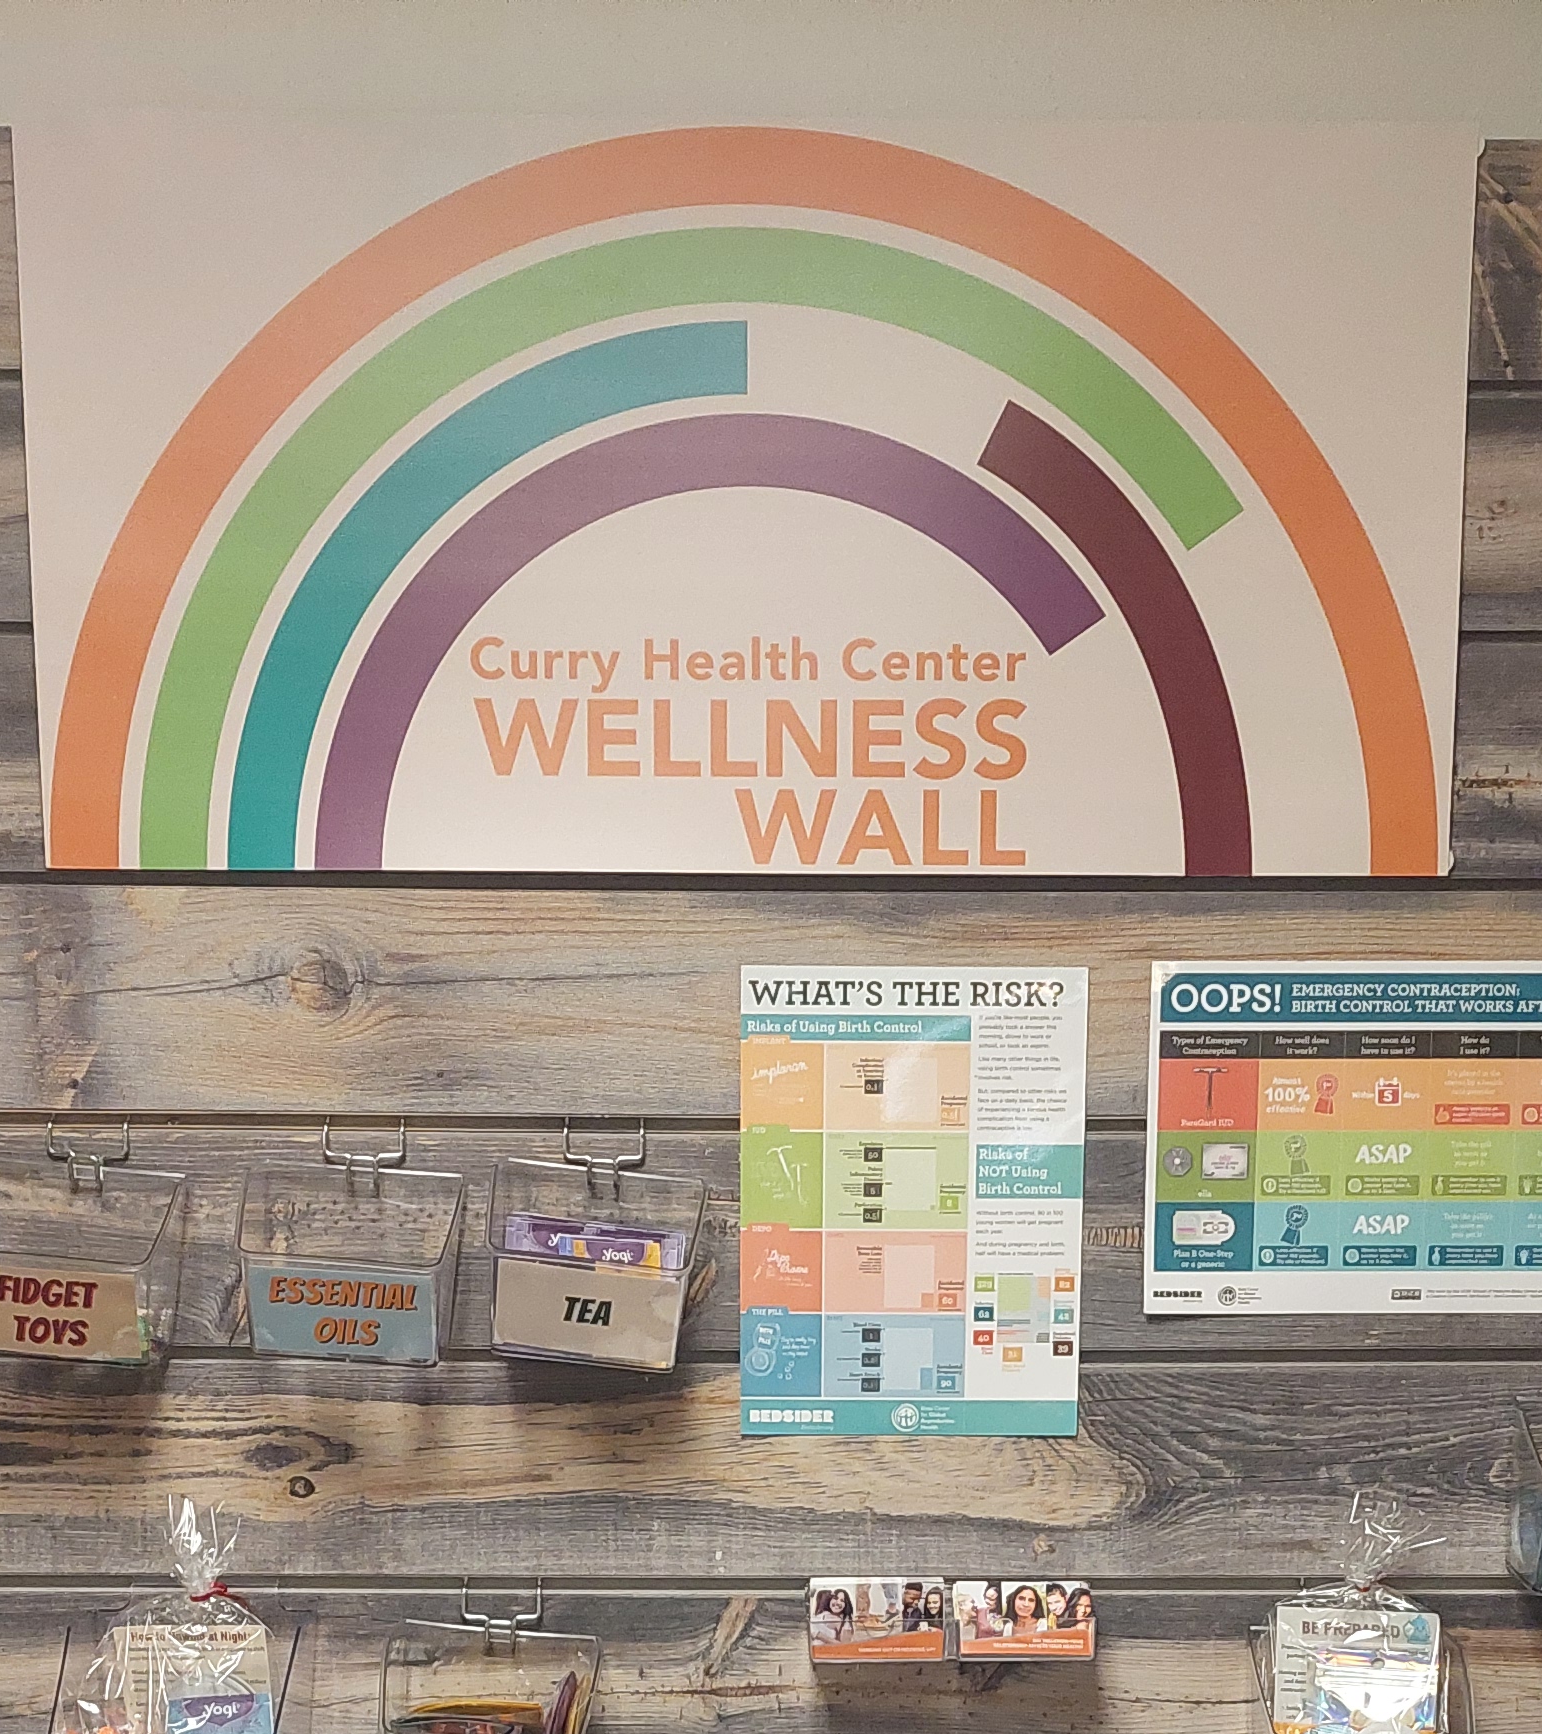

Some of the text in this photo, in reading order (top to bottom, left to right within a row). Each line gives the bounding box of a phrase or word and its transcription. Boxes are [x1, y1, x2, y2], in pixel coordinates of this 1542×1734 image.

[469, 636, 1027, 693] Curry Health Center
[473, 696, 1028, 781] WELLNESS
[734, 788, 1027, 867] WALL
[748, 979, 883, 1007] WHAT'S
[893, 981, 960, 1007] THE
[1171, 983, 1282, 1013] OOPS!
[1291, 984, 1384, 997] EMERGENCY
[1291, 1000, 1337, 1013] BIRTH
[1339, 1000, 1412, 1013] CONTROL
[1415, 1000, 1457, 1013] THAT
[1459, 1000, 1514, 1013] WORKS
[747, 1021, 922, 1037] Risks of Using Birth Control
[979, 1148, 1029, 1160] Risks of
[1355, 1143, 1412, 1164] ASAP
[979, 1165, 1048, 1182] NOT Using
[978, 1182, 1062, 1195] Birth Control
[1353, 1214, 1409, 1235] ASAP
[268, 1276, 418, 1312] ESSENTIAL
[562, 1296, 613, 1327] TEA
[12, 1315, 89, 1347] TOYS
[313, 1317, 381, 1346] OILS
[748, 1409, 834, 1423] BEDSIDER
[1302, 1620, 1319, 1635] BE
